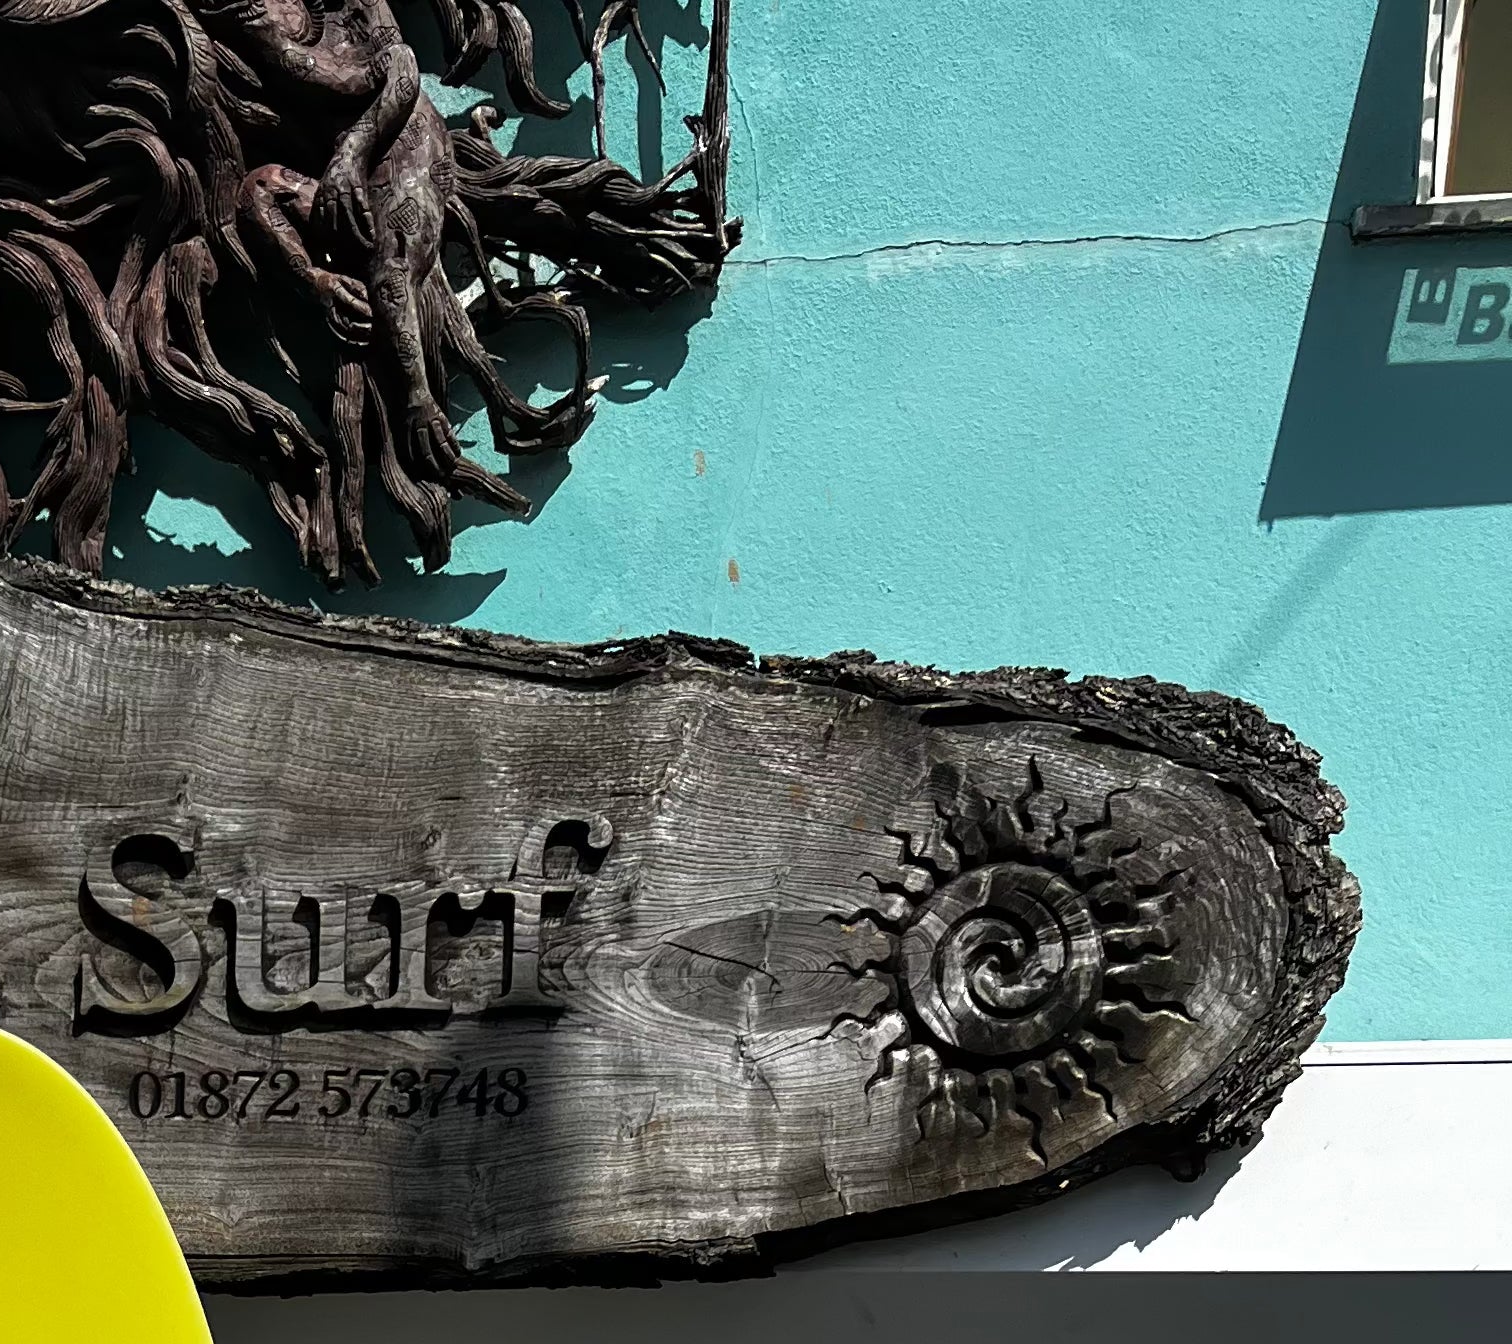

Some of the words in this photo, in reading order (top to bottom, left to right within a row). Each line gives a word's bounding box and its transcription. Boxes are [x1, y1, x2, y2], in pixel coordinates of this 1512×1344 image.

[74, 817, 616, 1037] Surf
[128, 1068, 300, 1121] 01872
[318, 1066, 531, 1120] 573748
